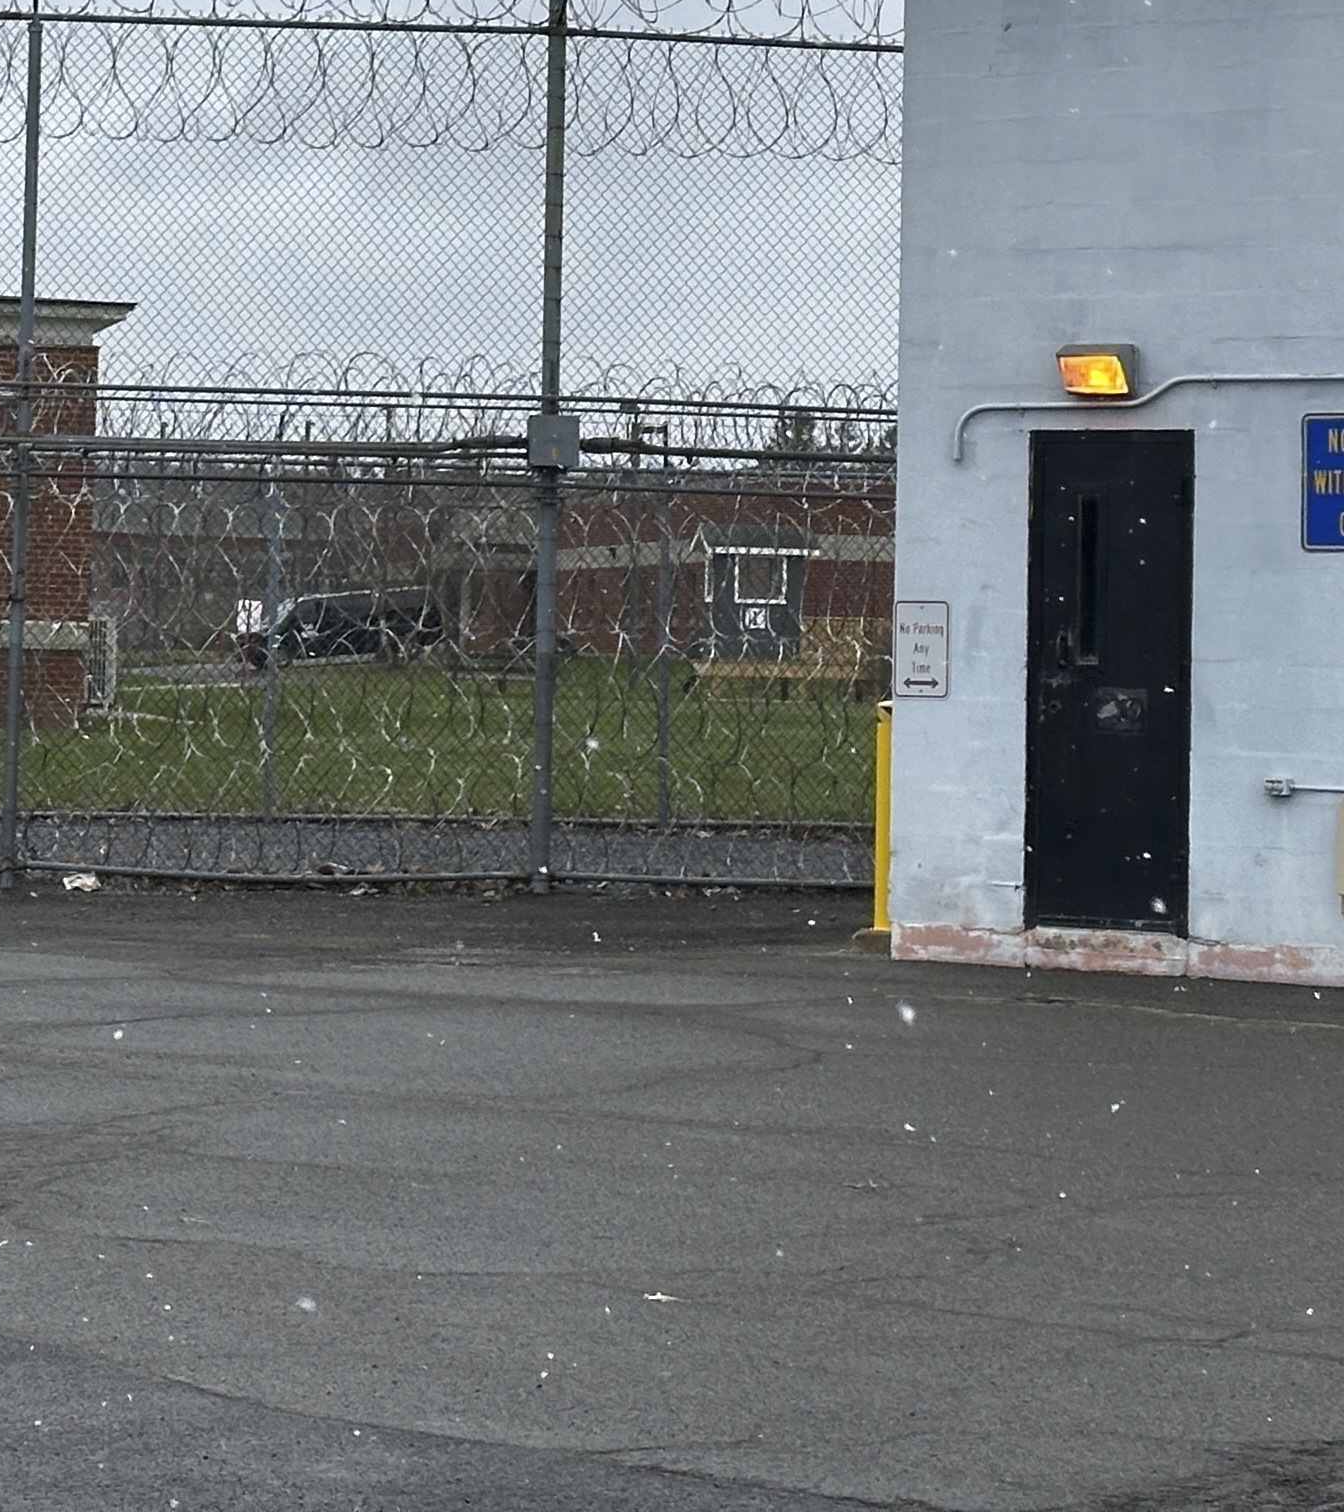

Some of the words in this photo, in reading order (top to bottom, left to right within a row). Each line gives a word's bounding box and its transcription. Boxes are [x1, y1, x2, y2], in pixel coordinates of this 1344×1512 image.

[899, 622, 911, 635] No
[912, 622, 944, 638] Parking
[912, 642, 930, 658] Any
[911, 660, 931, 674] Time
